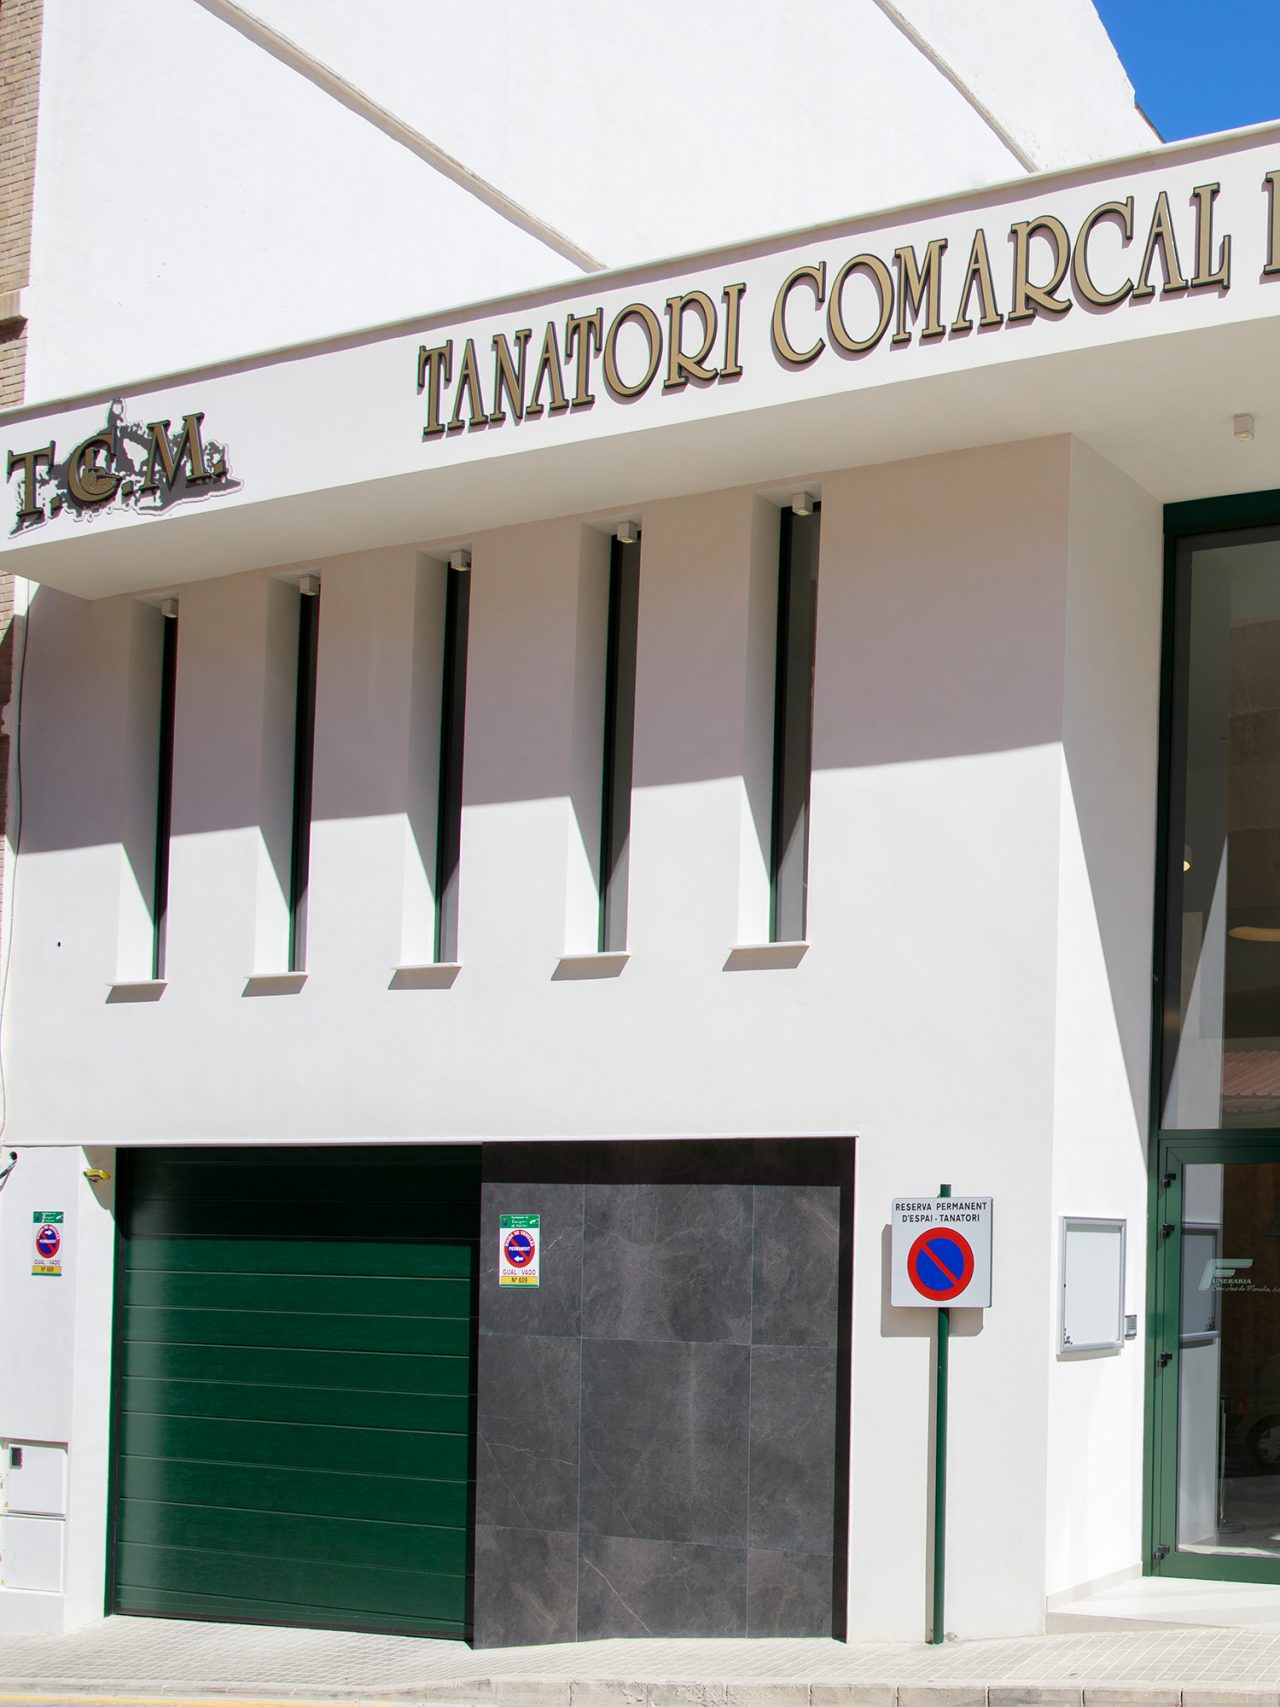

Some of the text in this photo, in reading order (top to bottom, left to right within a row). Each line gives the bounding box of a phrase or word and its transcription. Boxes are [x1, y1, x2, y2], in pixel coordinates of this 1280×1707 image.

[418, 283, 746, 436] TANATORI
[772, 182, 1232, 364] COMARCAL
[895, 1202, 988, 1211] RESERVA PERMANENT
[902, 1214, 933, 1223] D'ESPAI
[939, 1214, 980, 1222] TANATORI
